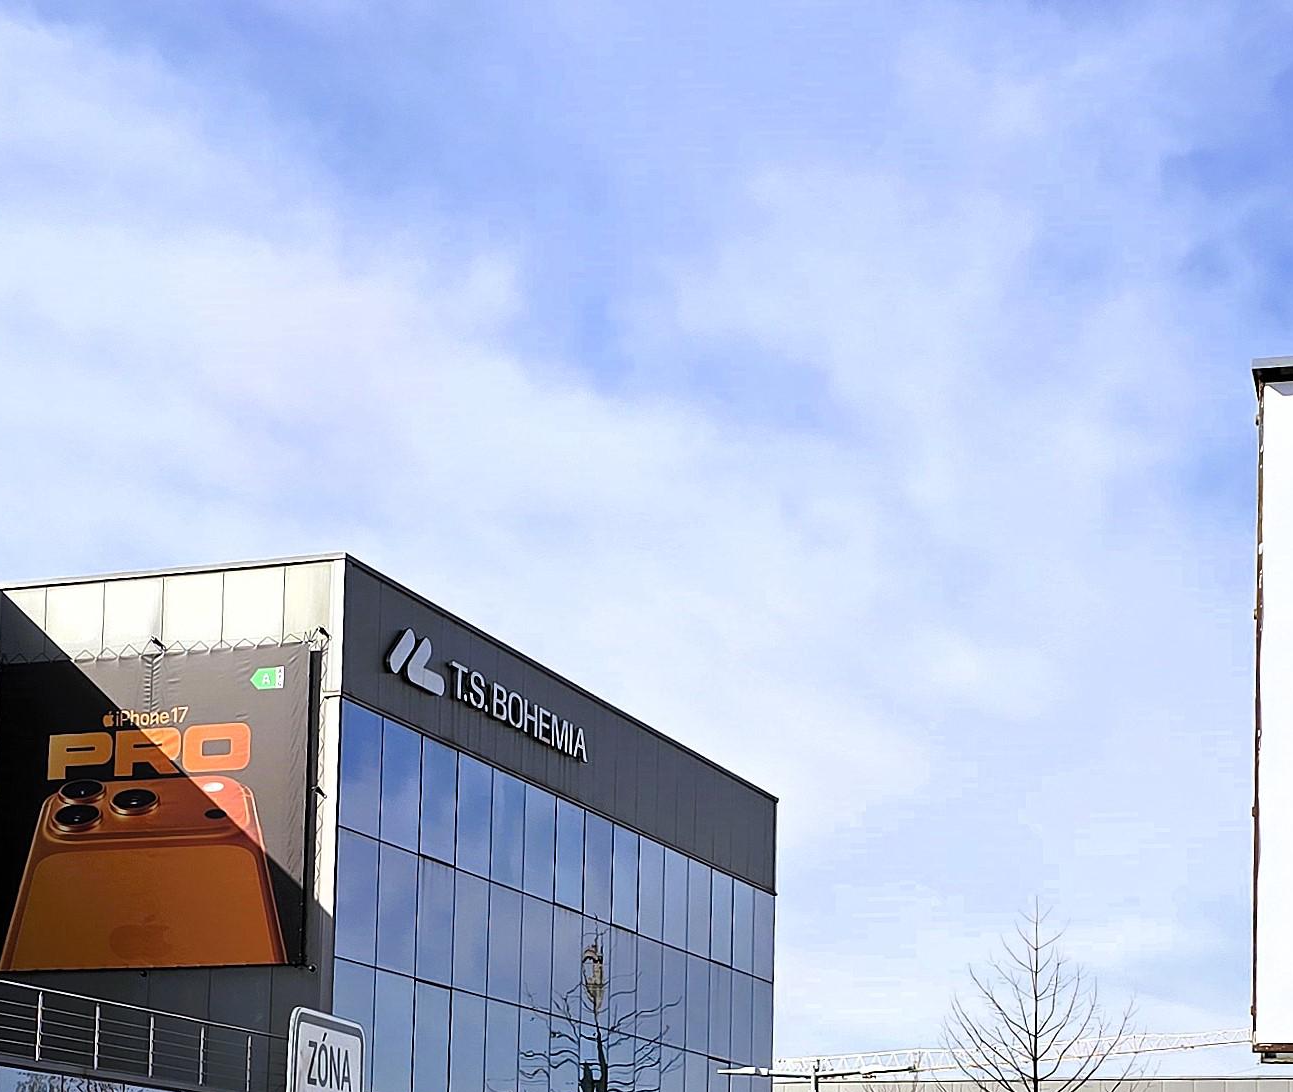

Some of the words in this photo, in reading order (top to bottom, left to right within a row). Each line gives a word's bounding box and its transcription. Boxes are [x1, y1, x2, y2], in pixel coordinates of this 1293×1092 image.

[115, 709, 170, 728] iPhone
[171, 706, 189, 725] 17
[47, 722, 252, 781] PRO
[306, 1032, 352, 1092] ZÓNA
